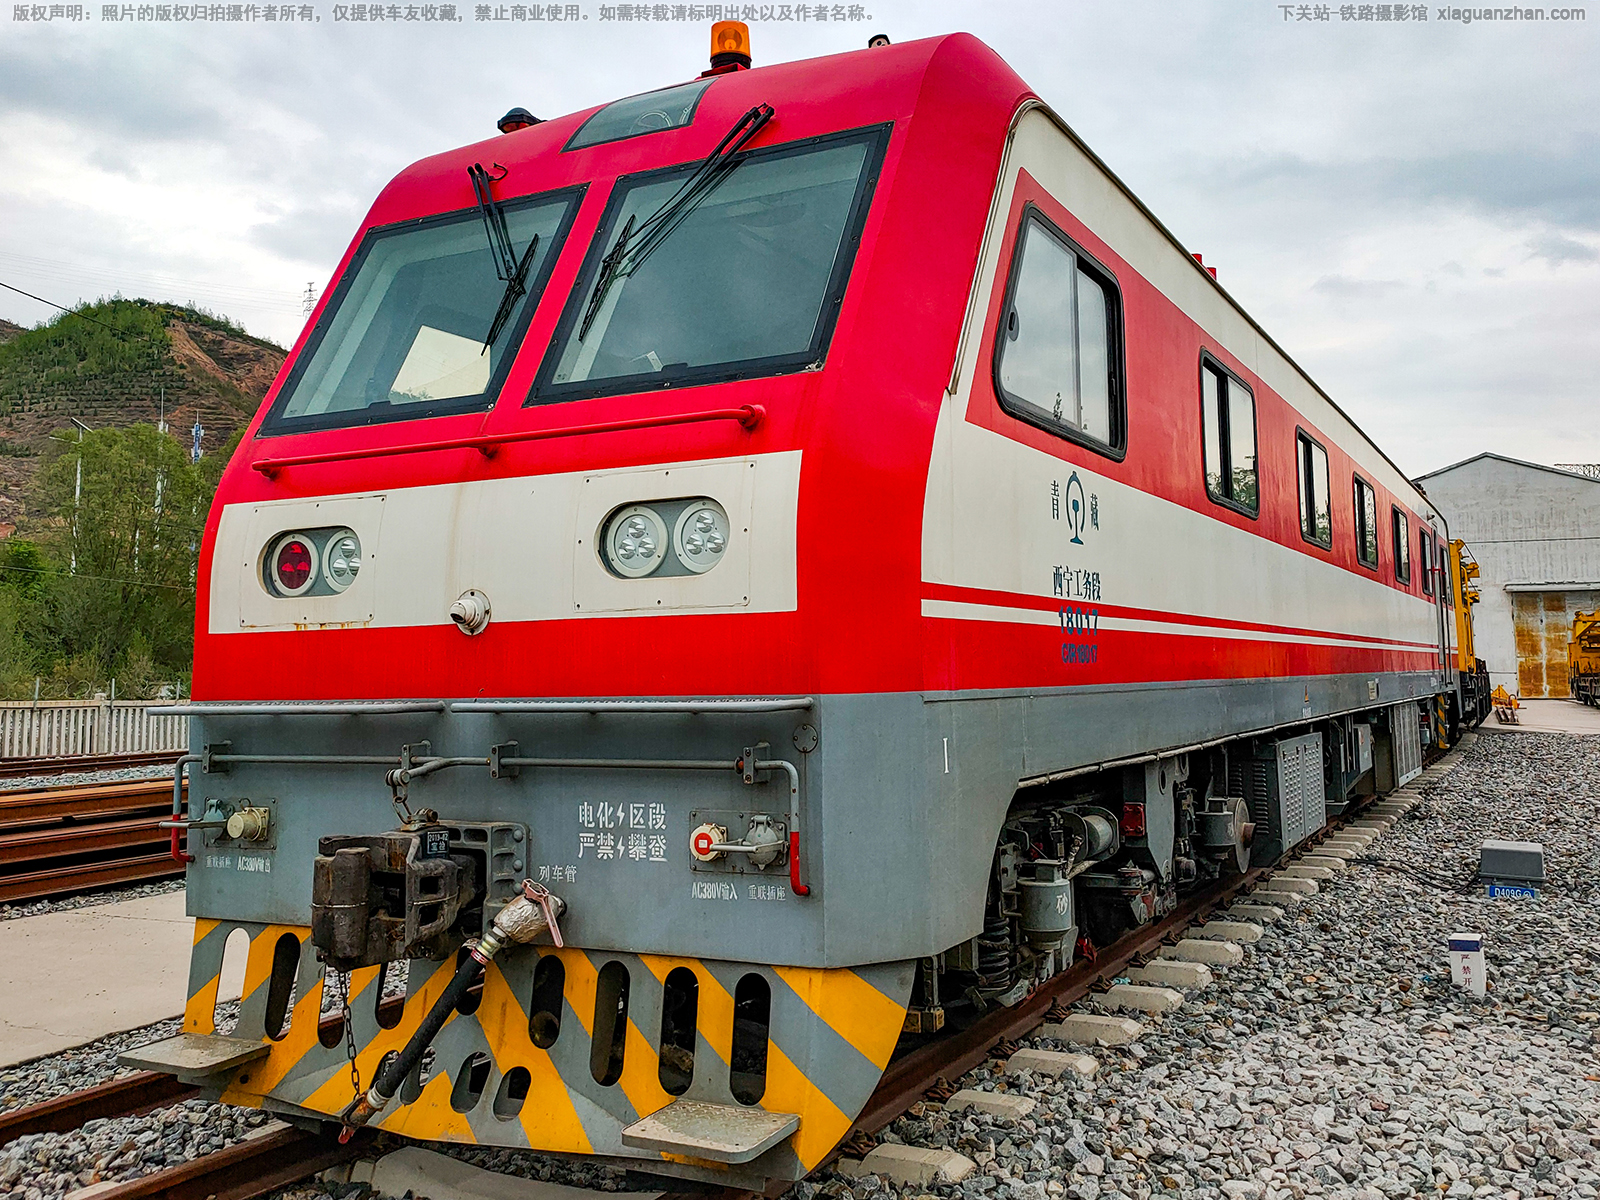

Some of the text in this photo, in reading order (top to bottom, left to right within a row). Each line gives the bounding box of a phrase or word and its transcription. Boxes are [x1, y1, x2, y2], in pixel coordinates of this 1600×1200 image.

[1053, 565, 1101, 601] 西宁工务段
[1059, 606, 1098, 636] 18017
[538, 864, 577, 883] 列车管
[691, 882, 786, 901] AC380V输入 重联插座
[1494, 887, 1521, 897] D409G
